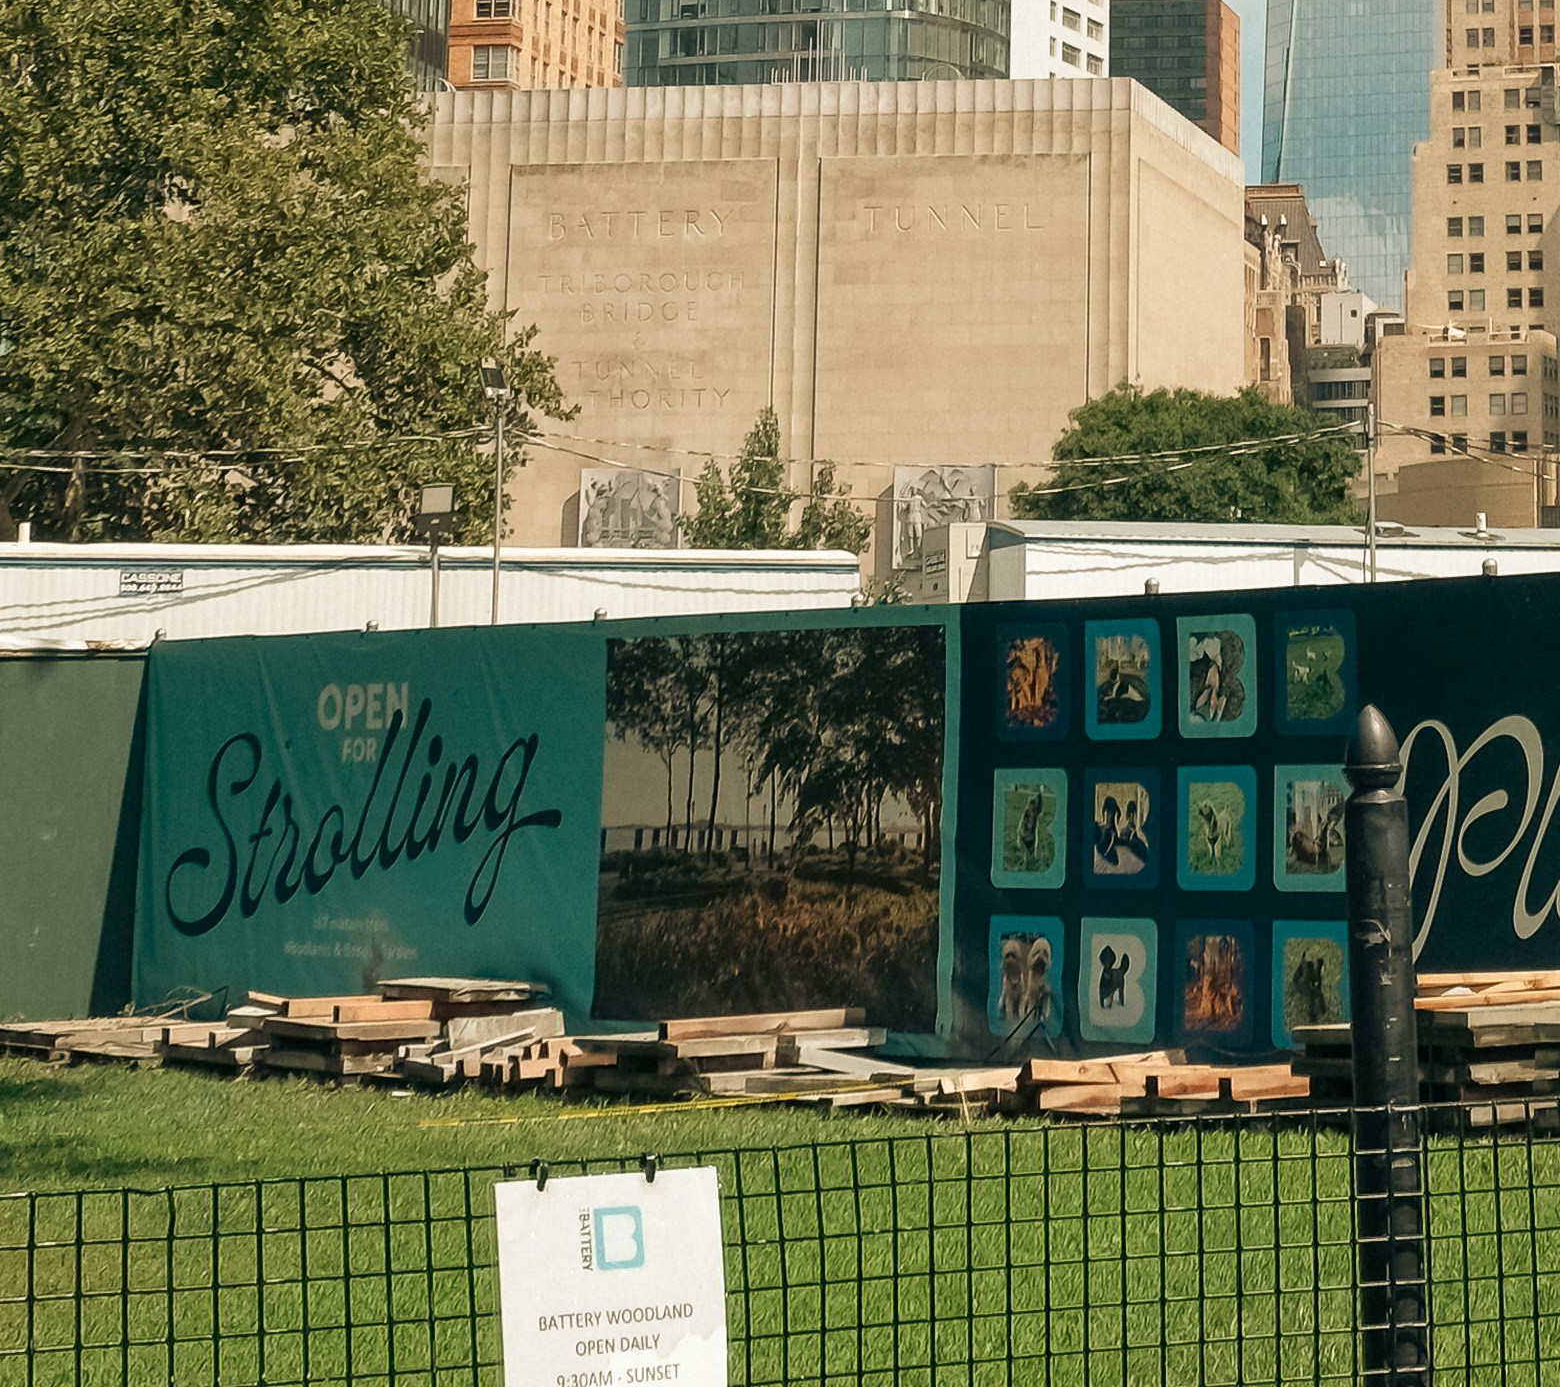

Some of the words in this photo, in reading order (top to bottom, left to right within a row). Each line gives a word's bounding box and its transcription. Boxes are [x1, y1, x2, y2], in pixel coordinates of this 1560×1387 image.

[548, 209, 734, 240] BATTERY
[864, 203, 1044, 233] TUNNEL
[538, 272, 744, 295] TRIBOROUGH
[581, 301, 698, 323] BRIDGE
[632, 331, 646, 351] &
[571, 360, 706, 381] TUNNEL
[121, 573, 182, 583] CASSONE
[317, 681, 410, 730] OPEN
[342, 738, 377, 764] FOR
[165, 697, 562, 937] Strolling
[579, 1213, 593, 1271] BATTERY
[539, 1311, 602, 1332] BATTERY
[606, 1303, 694, 1325] WOODLAND
[575, 1338, 616, 1356] OPEN
[620, 1333, 661, 1353] DAILY
[557, 1370, 613, 1387] 9:30AM
[626, 1364, 681, 1384] SUNSET
